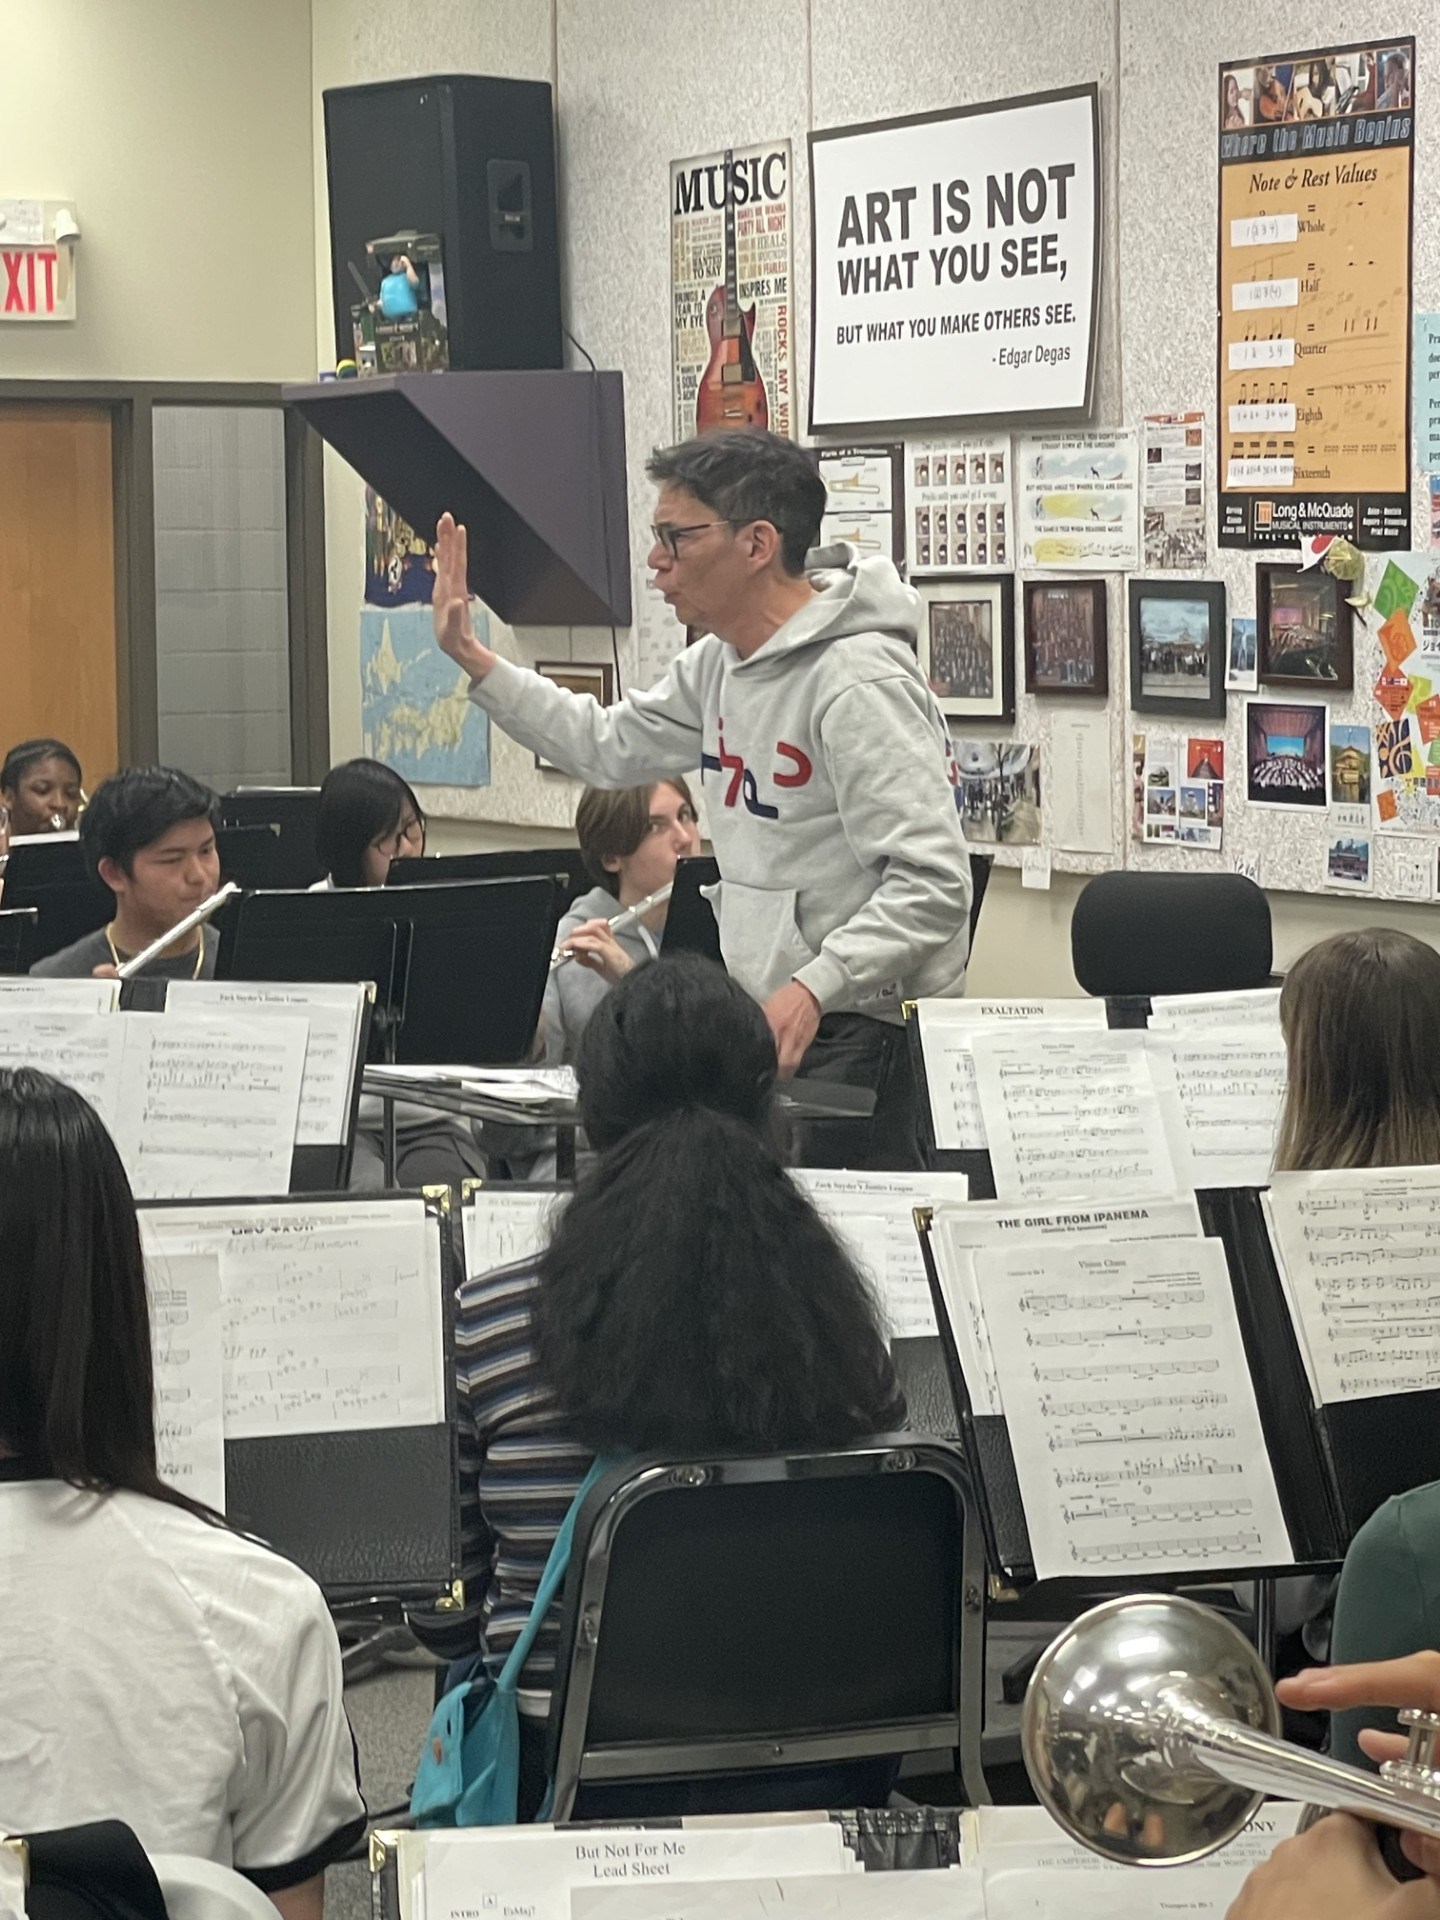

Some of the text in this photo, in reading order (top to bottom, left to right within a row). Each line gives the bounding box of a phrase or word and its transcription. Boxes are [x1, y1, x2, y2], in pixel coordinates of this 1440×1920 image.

[1221, 115, 1411, 158] Where the Music Begins
[674, 153, 786, 215] MUSIC
[1249, 163, 1378, 194] Note & Rest Values
[837, 163, 1075, 248] ART IS NOT
[1297, 219, 1325, 234] Whole
[838, 234, 1067, 296] WHAT YOU SEE,
[0, 251, 57, 313] XIT
[739, 277, 787, 300] INSPIRES ME
[1301, 279, 1322, 293] Half
[777, 305, 788, 362] ROCKS
[836, 303, 1076, 345] BUT WHAT YOU MAKE OTHERS SEE.
[999, 348, 1032, 369] Edgar
[1035, 345, 1071, 366] Degas
[1294, 343, 1327, 358] Quarter
[778, 369, 789, 395] MY
[1296, 408, 1323, 425] Eighth
[1293, 466, 1330, 480] Sixteenth
[1273, 501, 1354, 521] Long & McQuade
[1272, 521, 1348, 530] MUSICAL INSTRUMENTS
[981, 1006, 1044, 1015] EXALTATION
[996, 1209, 1149, 1229] THE GIRL FROM IPANEMA
[576, 1842, 686, 1860] But Not For Me
[594, 1861, 671, 1878] Lead Sheet
[450, 1910, 479, 1919] INTRO
